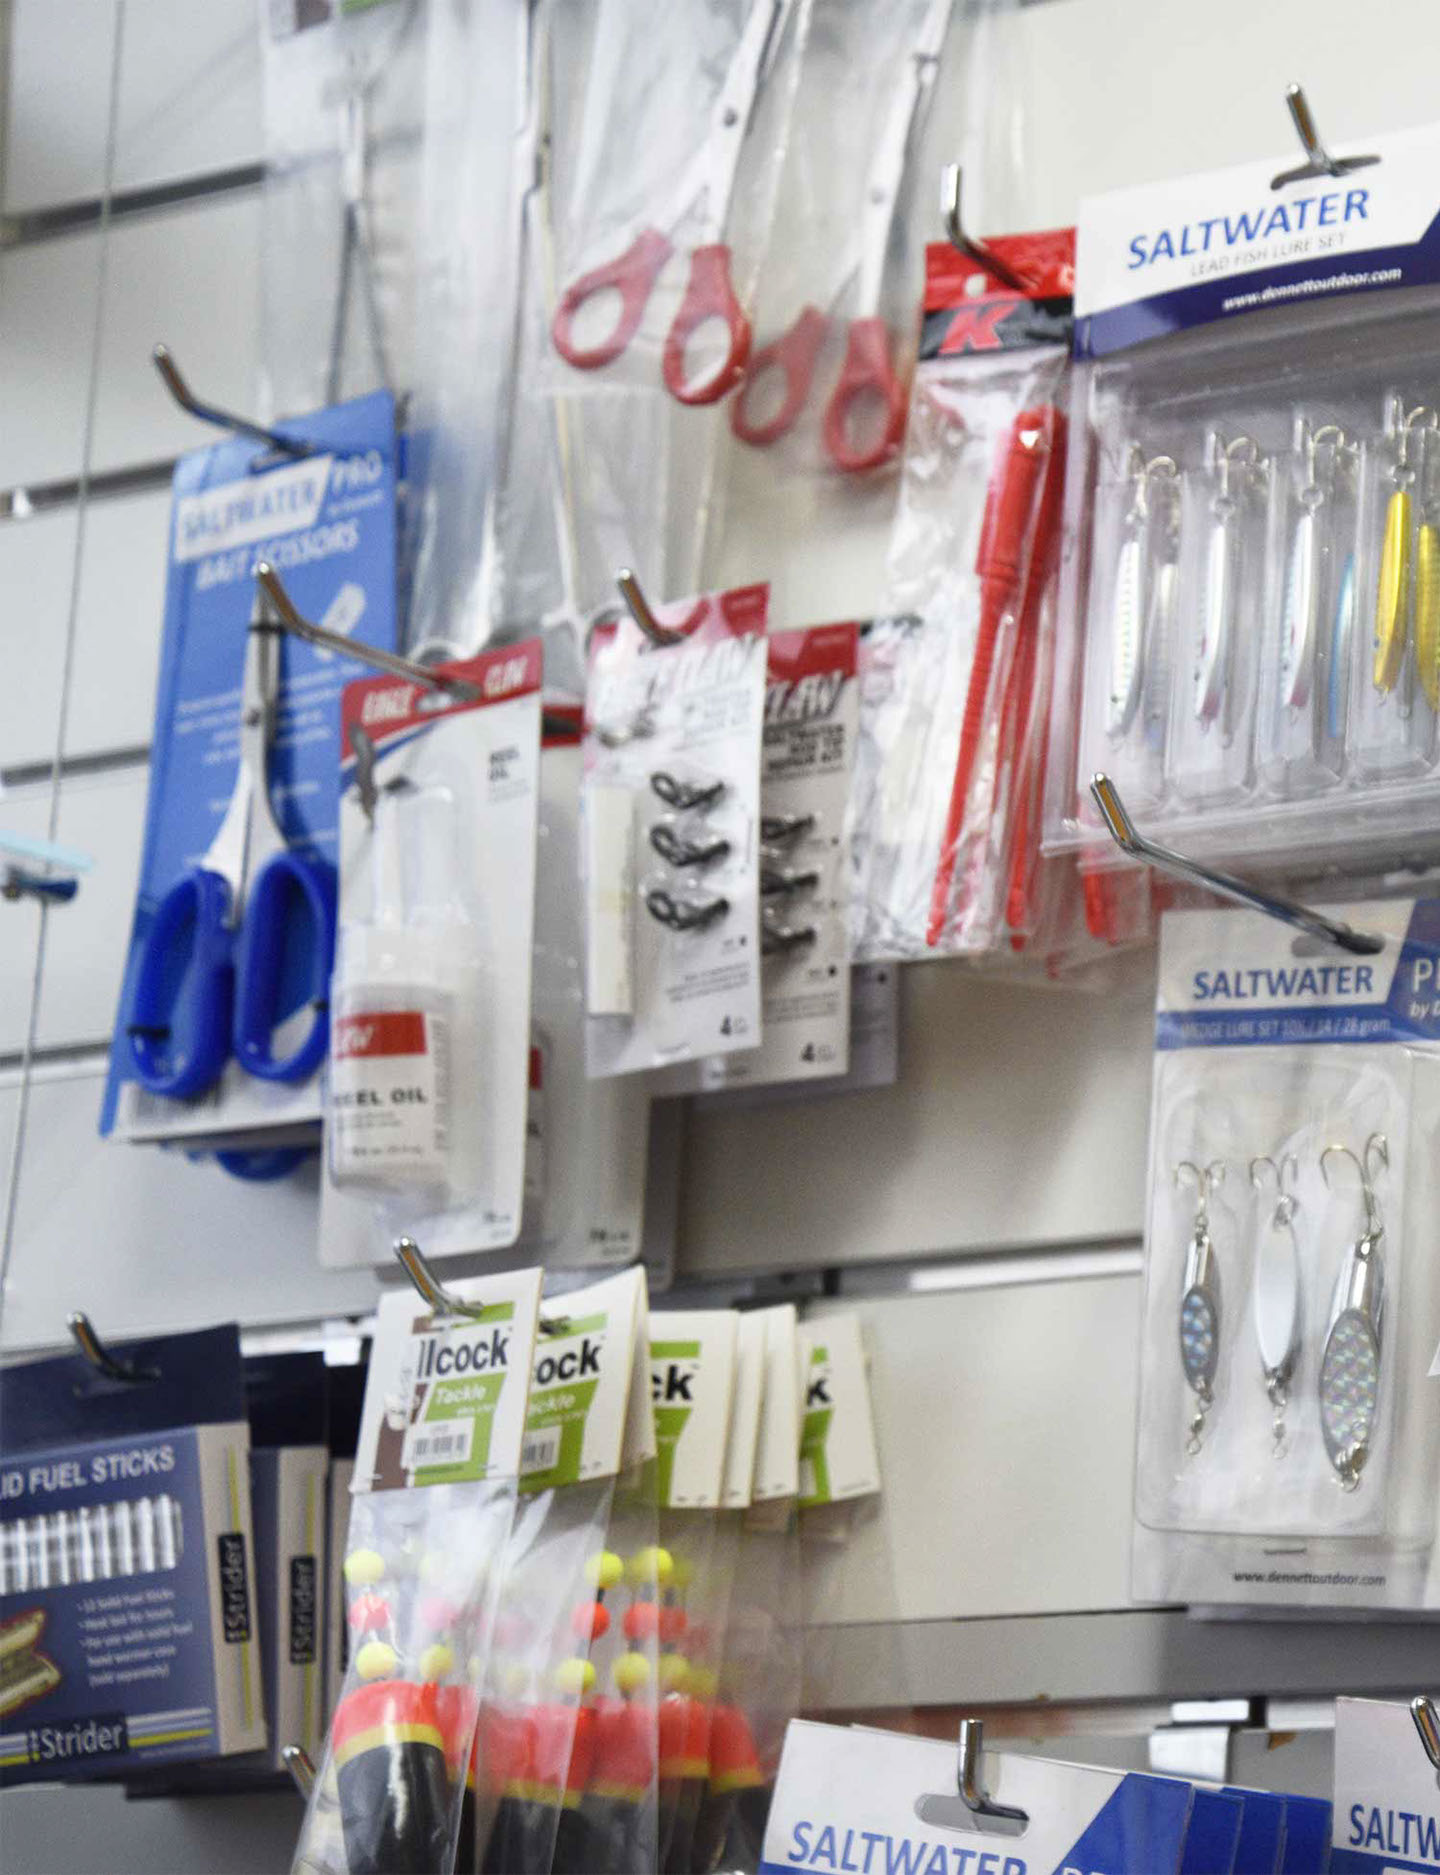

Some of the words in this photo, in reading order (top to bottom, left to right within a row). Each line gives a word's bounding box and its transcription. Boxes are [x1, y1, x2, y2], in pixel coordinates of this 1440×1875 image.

[1128, 189, 1369, 269] SALTWATER
[1191, 255, 1230, 277] LEAD
[1318, 231, 1346, 248] SET
[1222, 268, 1402, 310] www.dennettoutdoor.com
[1193, 965, 1374, 1000] SALTWATER
[1410, 1001, 1429, 1019] by
[417, 1329, 509, 1378] llcock
[29, 1461, 87, 1494] FUEL
[91, 1445, 176, 1483] STICKS
[1234, 1570, 1386, 1587] www.dennettoutdoor.com
